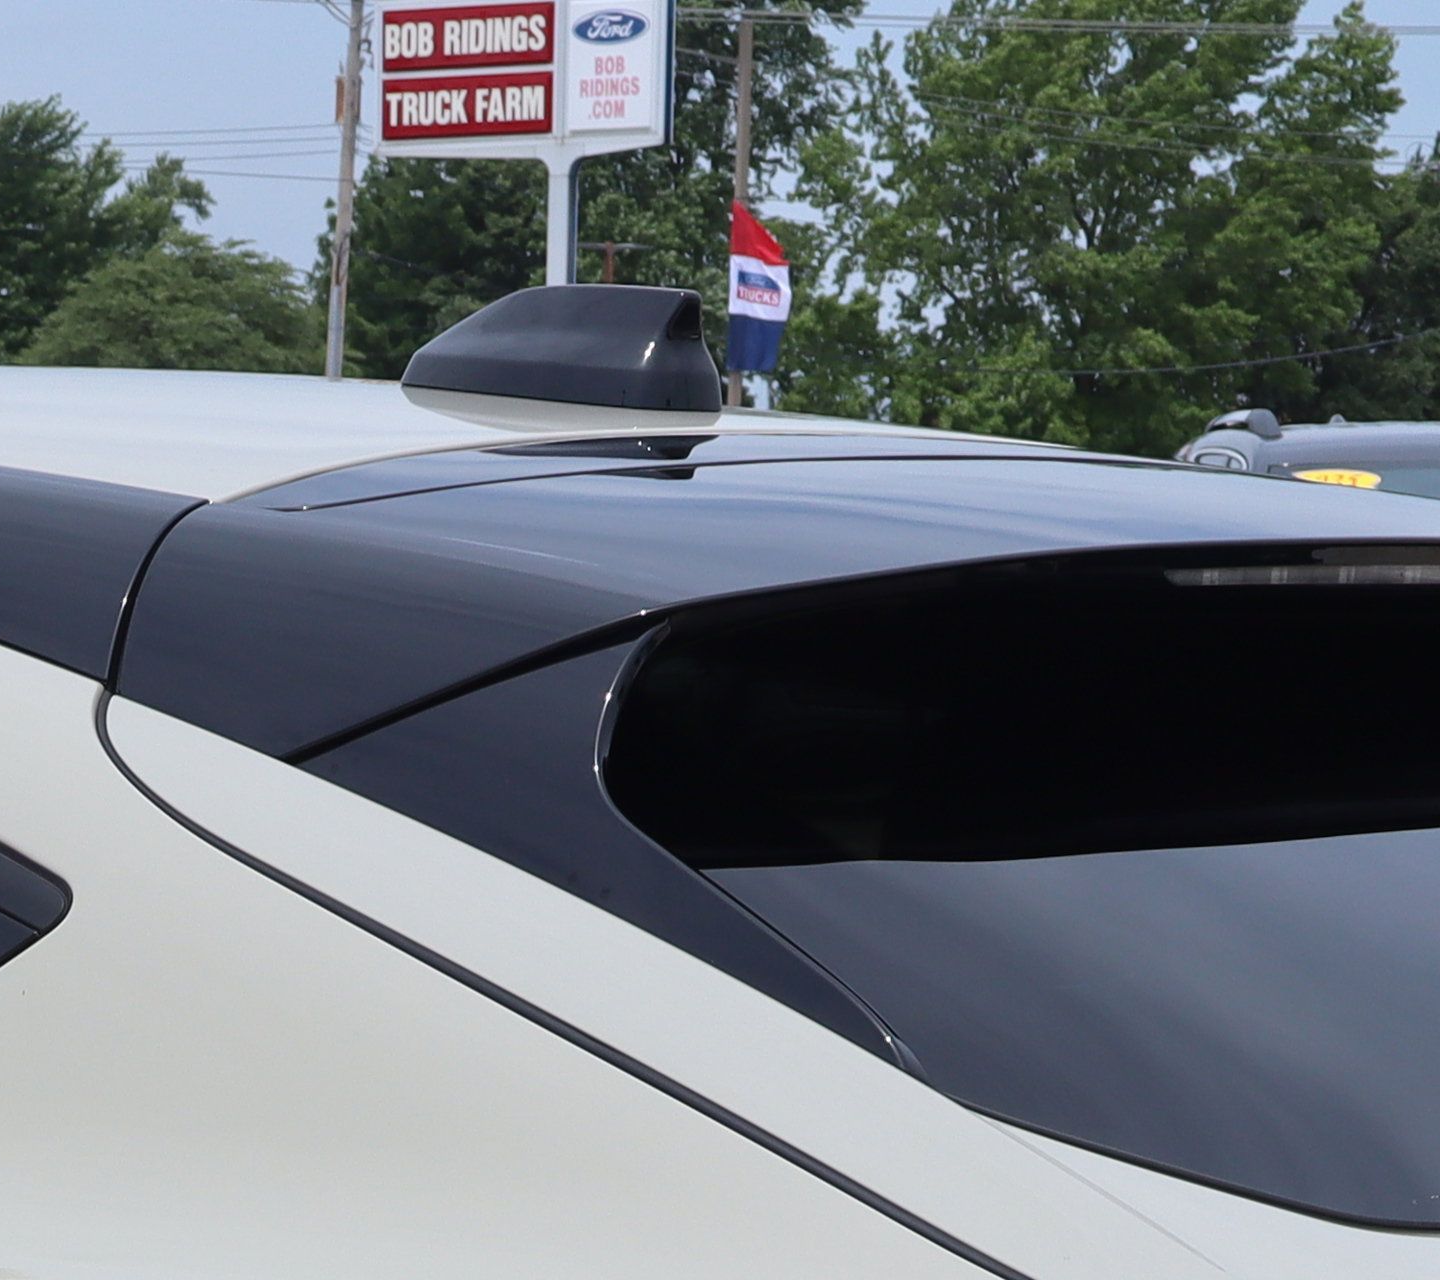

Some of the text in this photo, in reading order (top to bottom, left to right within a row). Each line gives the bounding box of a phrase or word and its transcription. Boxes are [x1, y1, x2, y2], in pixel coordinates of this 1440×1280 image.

[384, 14, 546, 59] BOB RIDINGS
[586, 13, 633, 39] Ford
[594, 56, 625, 76] BOB
[579, 77, 640, 98] RIDINGS
[385, 85, 545, 127] TRUCK FARM
[589, 100, 625, 119] .COM
